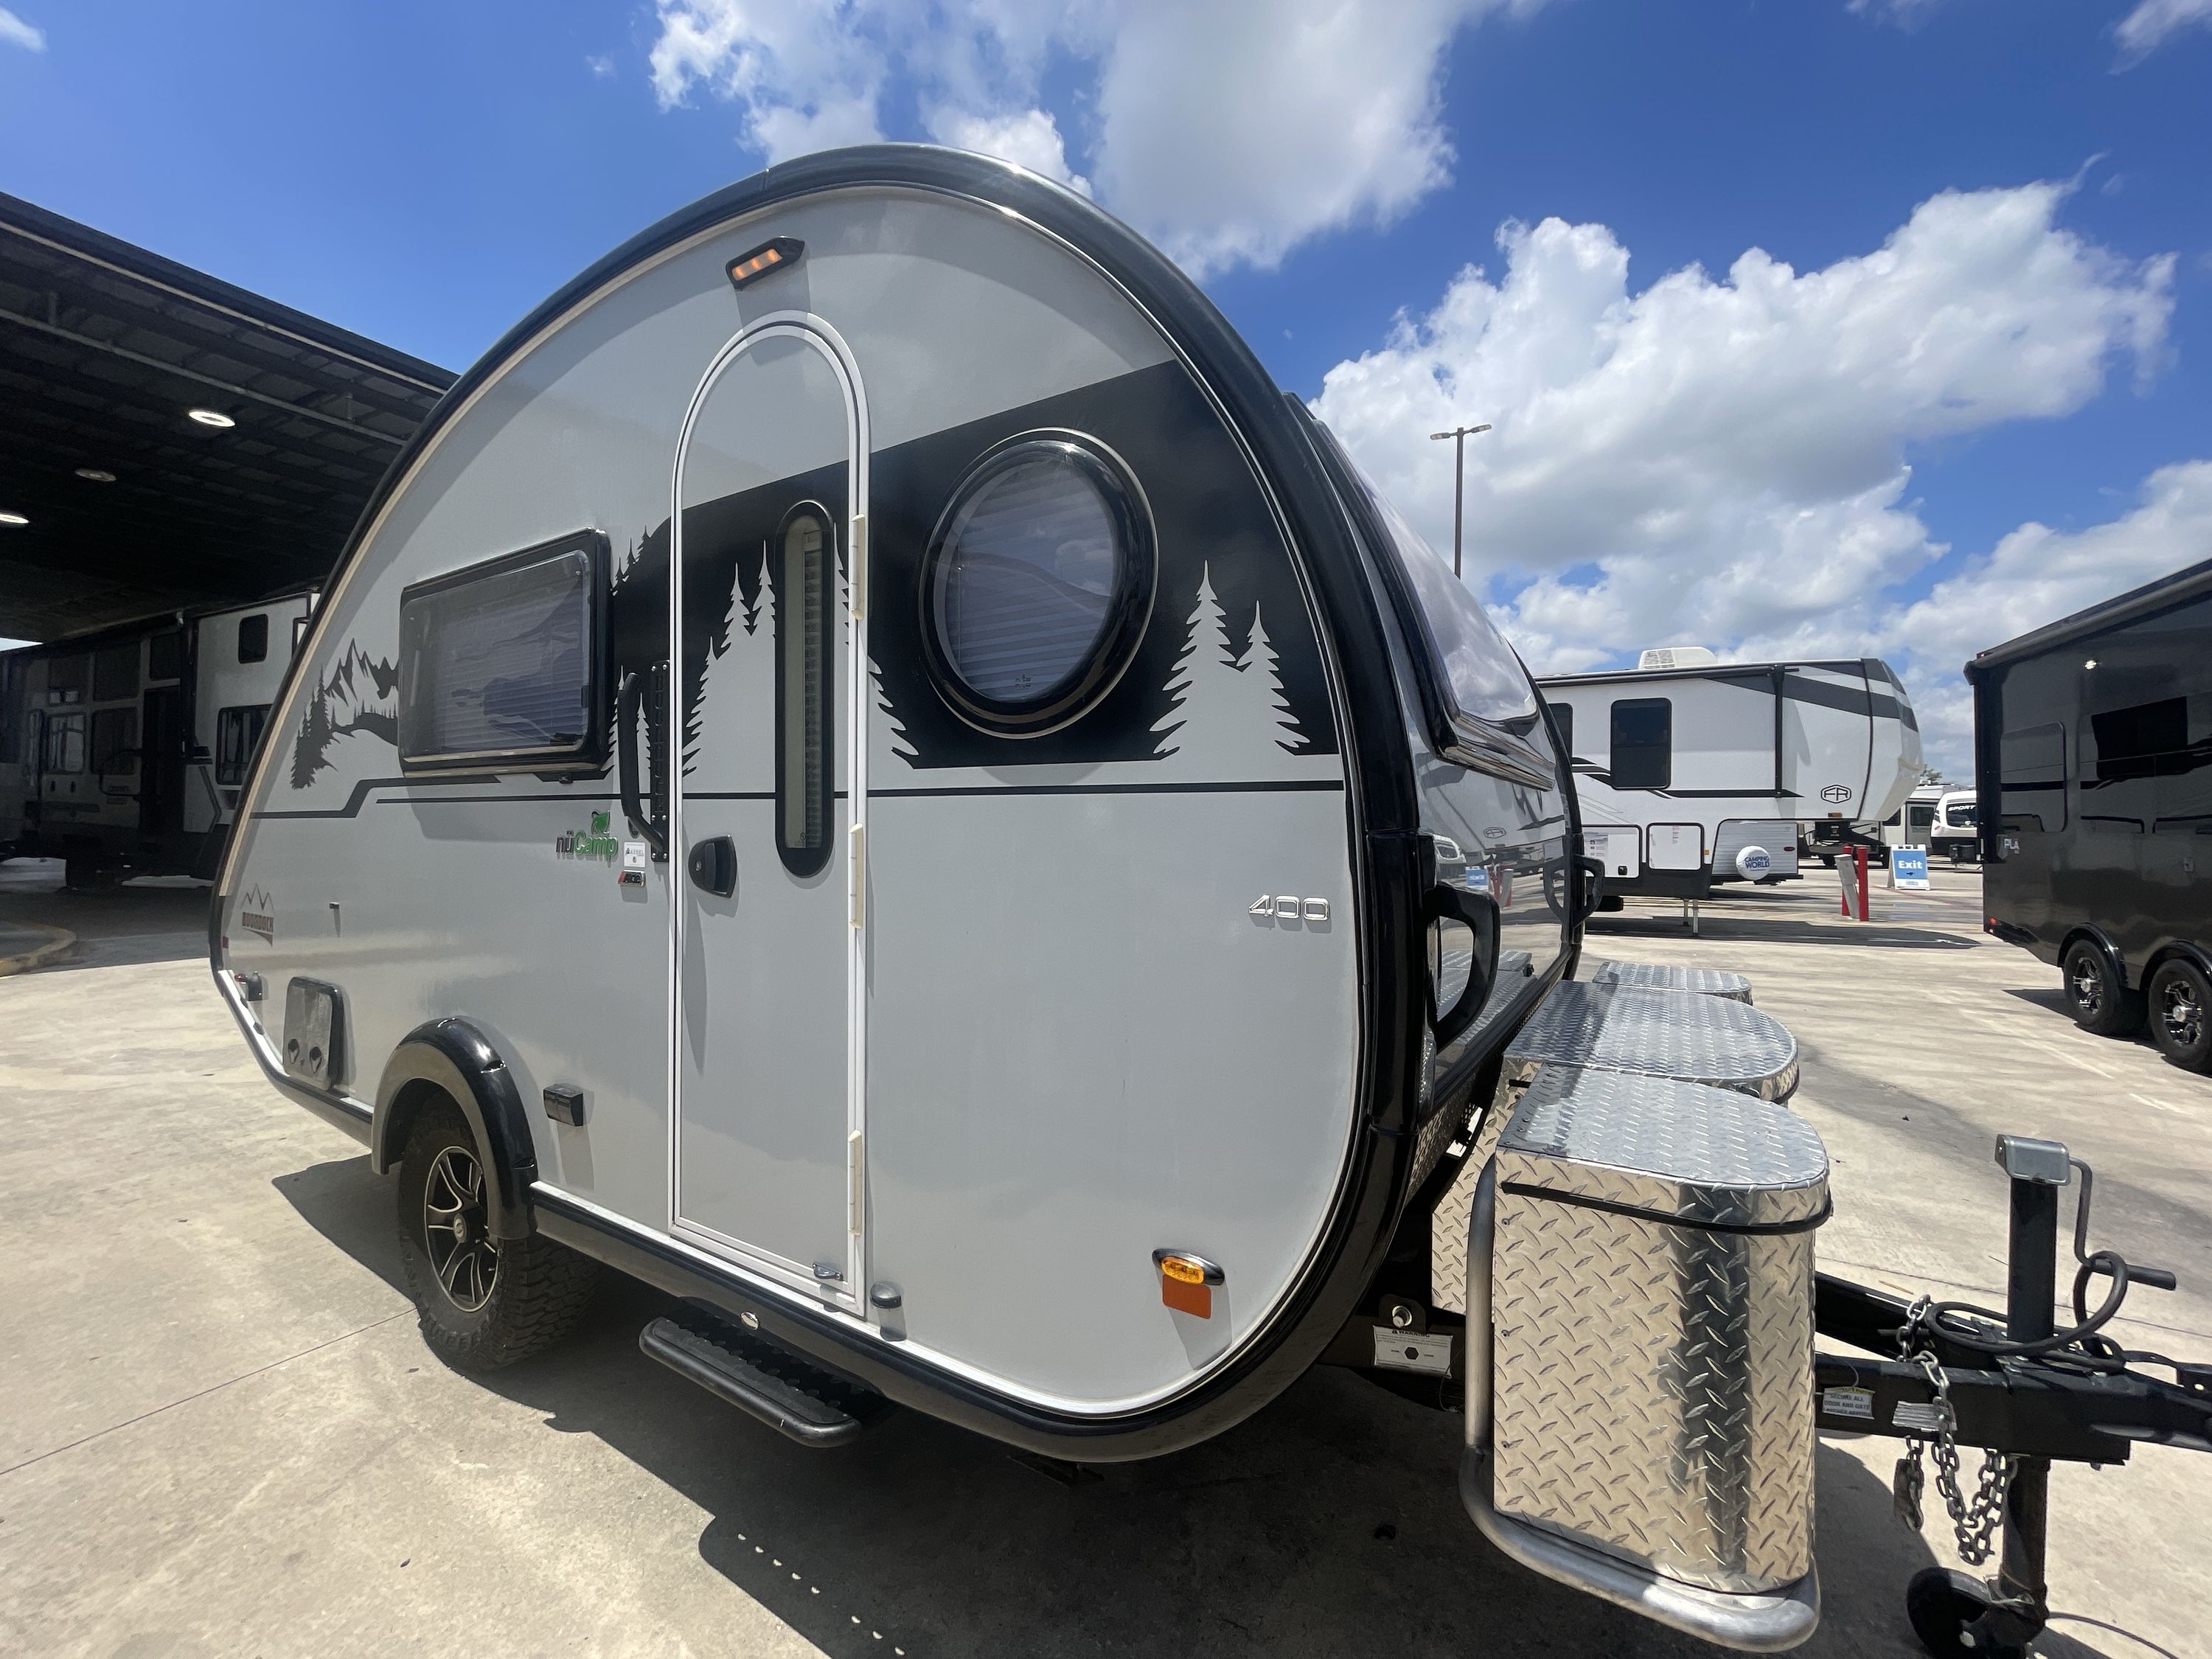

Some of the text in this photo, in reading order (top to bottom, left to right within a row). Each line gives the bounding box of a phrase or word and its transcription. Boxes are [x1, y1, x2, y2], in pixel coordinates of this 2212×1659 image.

[1823, 787, 1848, 801] FR
[556, 830, 619, 862] nüCamp
[1898, 860, 1923, 869] Exit
[1248, 894, 1329, 921] 400
